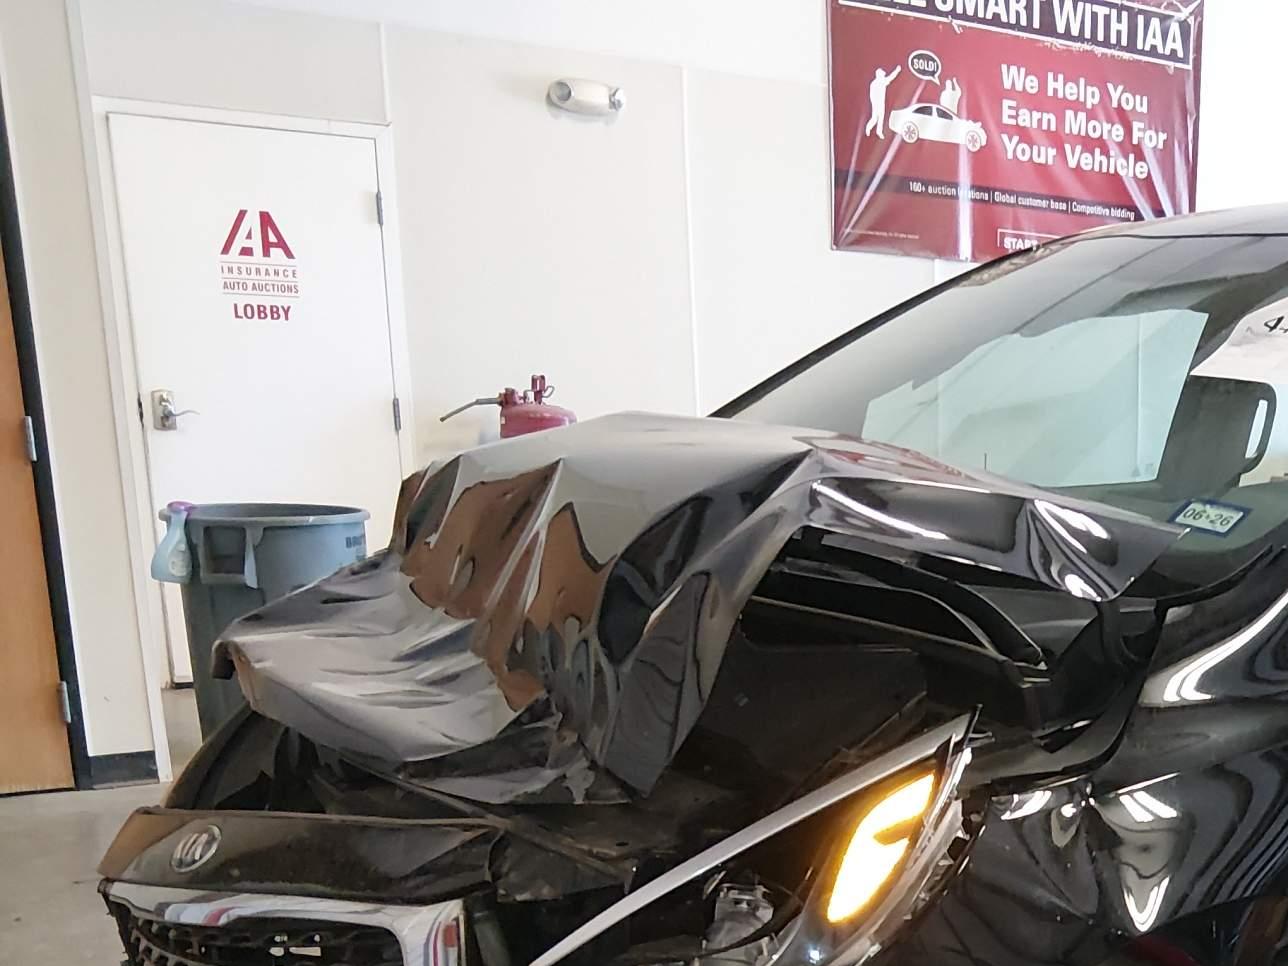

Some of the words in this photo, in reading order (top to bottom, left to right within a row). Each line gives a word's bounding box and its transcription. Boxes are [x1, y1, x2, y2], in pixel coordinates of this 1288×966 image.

[1052, 0, 1128, 46] WITH
[1136, 15, 1184, 58] IAA
[913, 59, 938, 71] SOLD!
[1001, 64, 1039, 94] We
[1047, 72, 1100, 108] Help
[1107, 83, 1148, 113] You
[1002, 99, 1056, 131] Earn
[1065, 110, 1124, 142] More
[1132, 121, 1167, 149] For
[1001, 134, 1057, 165] Your
[1064, 144, 1148, 179] Vehicle
[928, 185, 957, 197] auction
[957, 186, 989, 201] lations
[994, 191, 1017, 204] Global
[1018, 196, 1049, 209] customer
[1050, 199, 1067, 210] base
[1072, 201, 1110, 216] Competitive
[1110, 207, 1135, 221] bidding
[220, 264, 298, 279] INSURANCE
[223, 281, 249, 292] AUTO
[251, 283, 300, 295] AUCTIONS
[233, 303, 292, 321] LOBBY
[1183, 507, 1208, 521] 06
[1209, 513, 1234, 527] 26
